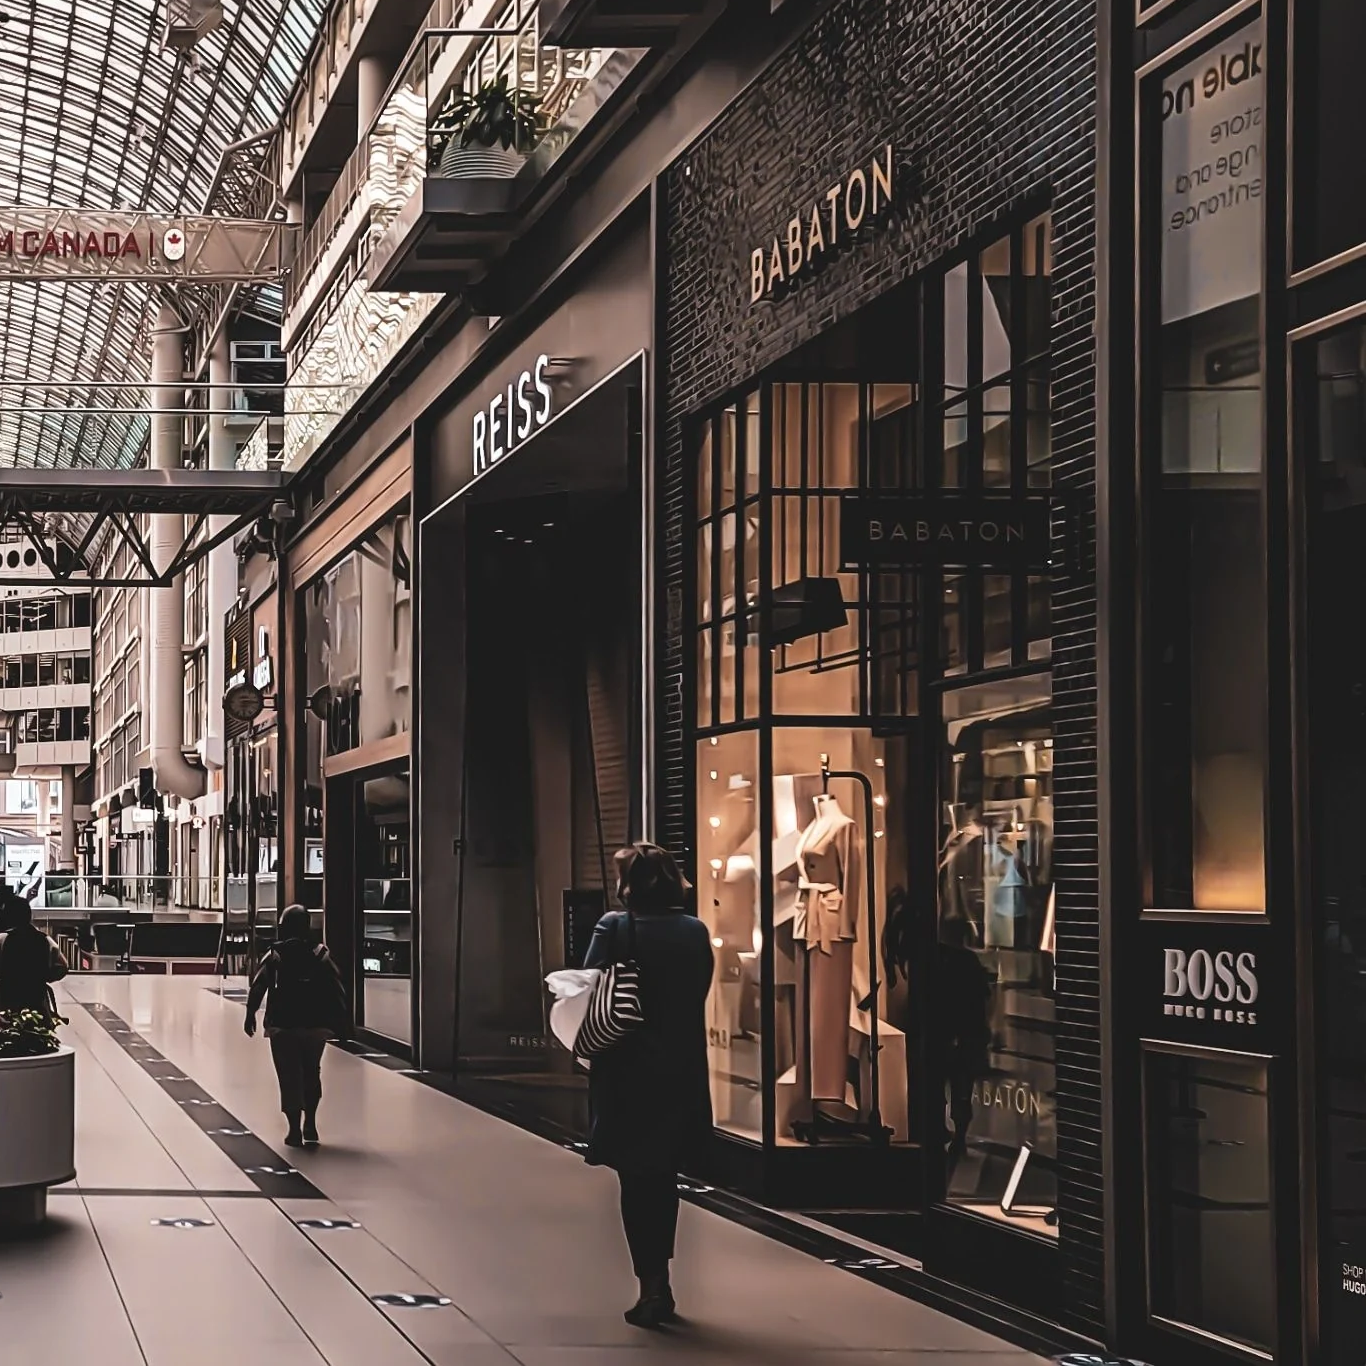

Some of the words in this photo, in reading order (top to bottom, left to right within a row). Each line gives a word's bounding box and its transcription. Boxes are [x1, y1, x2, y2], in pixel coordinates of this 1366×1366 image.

[750, 144, 892, 305] BABATON
[22, 230, 142, 259] CANADA
[473, 353, 550, 476] REISS
[869, 519, 1025, 543] BABATON
[1163, 948, 1259, 1004] BOSS
[971, 1080, 1040, 1116] ABATON
[1342, 1278, 1366, 1296] HUGO
